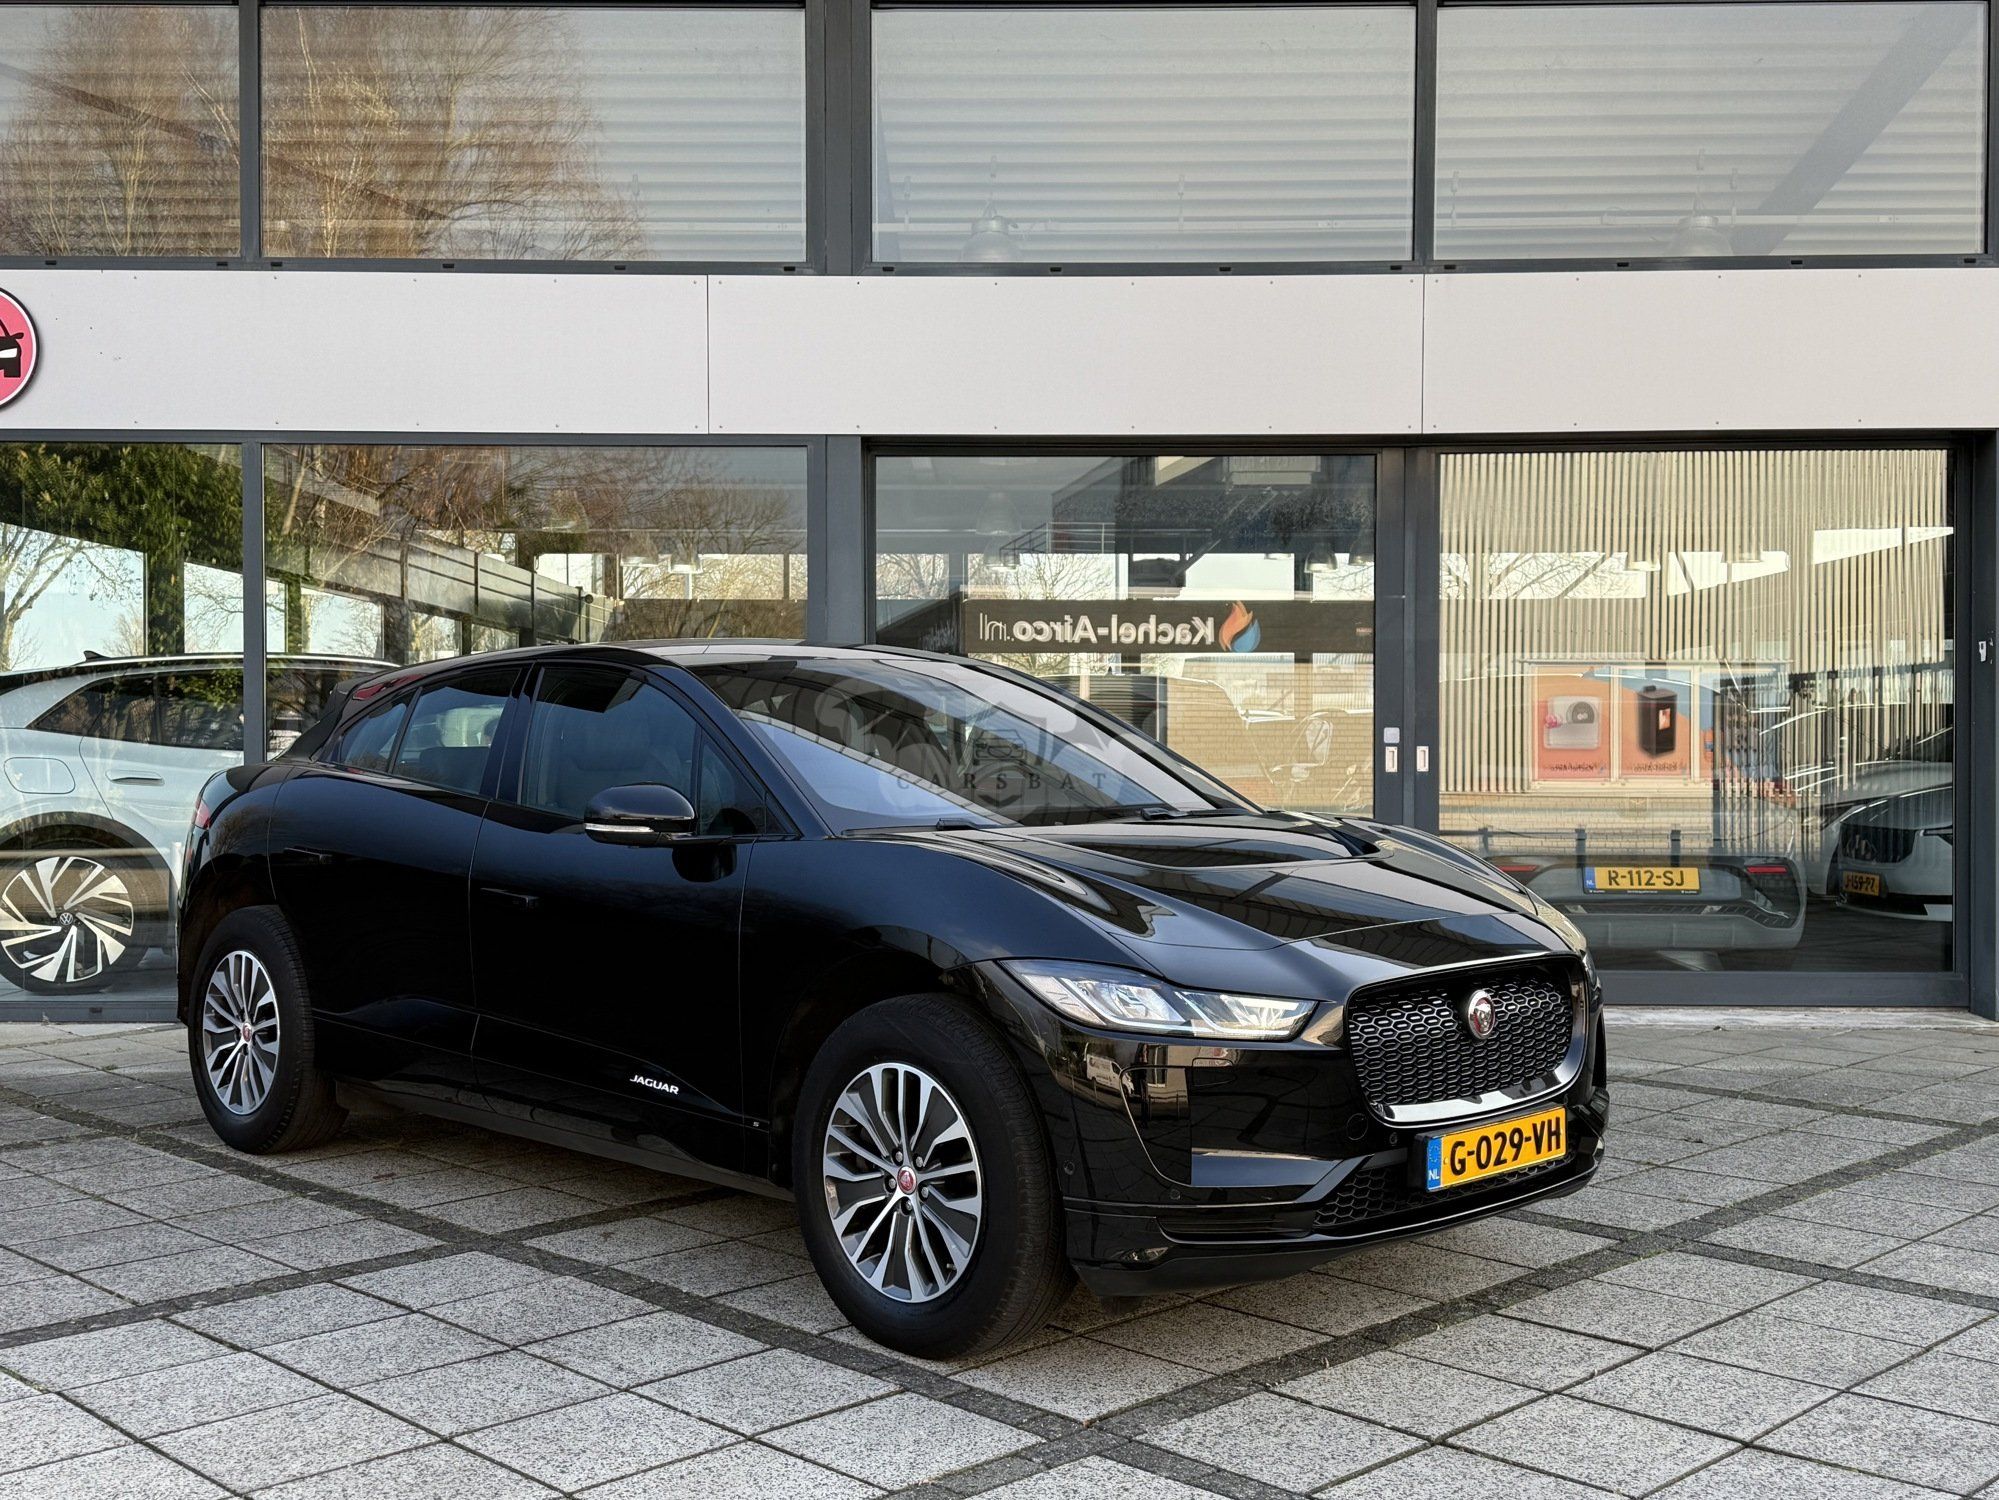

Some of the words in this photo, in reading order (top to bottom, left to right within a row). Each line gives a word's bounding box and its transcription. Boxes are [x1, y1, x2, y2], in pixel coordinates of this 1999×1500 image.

[1608, 869, 1685, 887] R-112-SJ
[629, 1074, 679, 1095] JAGUAR
[1450, 1116, 1561, 1176] G-029-VH
[1428, 1169, 1440, 1180] NL
